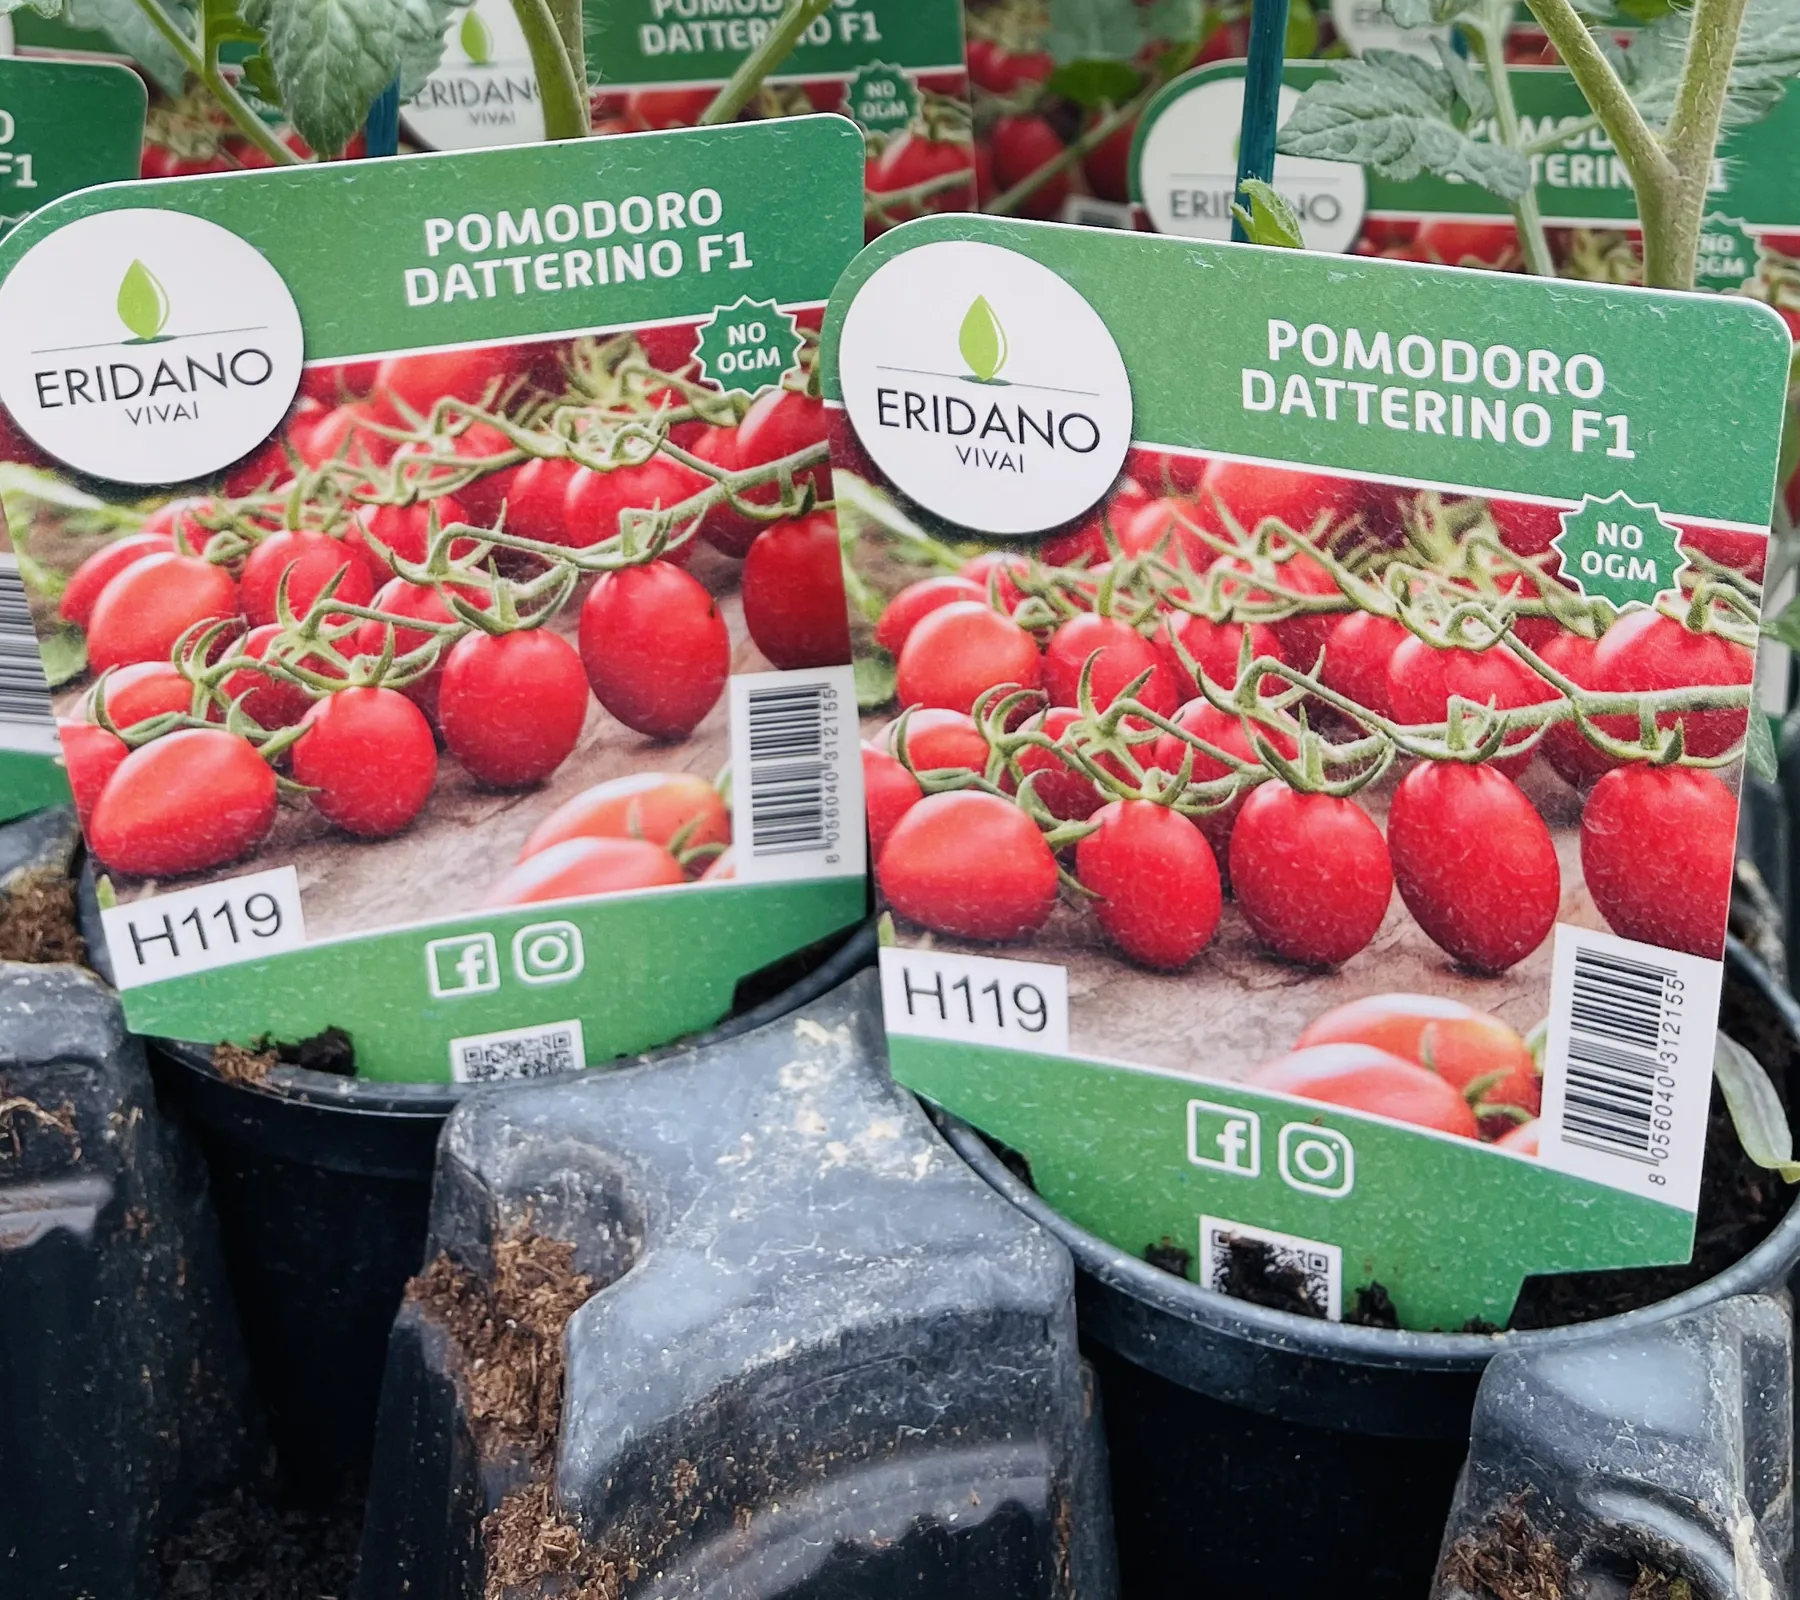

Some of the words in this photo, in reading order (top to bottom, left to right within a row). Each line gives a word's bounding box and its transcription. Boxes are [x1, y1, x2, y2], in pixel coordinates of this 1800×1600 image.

[641, 13, 832, 56] DATTERO
[839, 11, 883, 43] F1
[413, 76, 541, 108] ERIDAN
[864, 79, 897, 99] NO
[424, 187, 723, 258] POMODORO
[1169, 188, 1342, 224] ERINO
[404, 239, 683, 308] DATTERINO
[697, 231, 754, 273] F1
[727, 321, 767, 346] NO
[34, 348, 273, 409] ERIDANO
[717, 346, 782, 374] OGM
[1267, 318, 1605, 399] POMODORO
[125, 400, 200, 426] VIVAI
[877, 387, 1101, 454] ERIDANO
[1241, 367, 1552, 449] DATTERINO
[1571, 408, 1636, 459] F1
[955, 444, 1025, 474] VIVAI
[1596, 520, 1644, 550] NO
[1580, 550, 1658, 585] OGM
[127, 891, 283, 966] H119
[902, 966, 1048, 1033] H119
